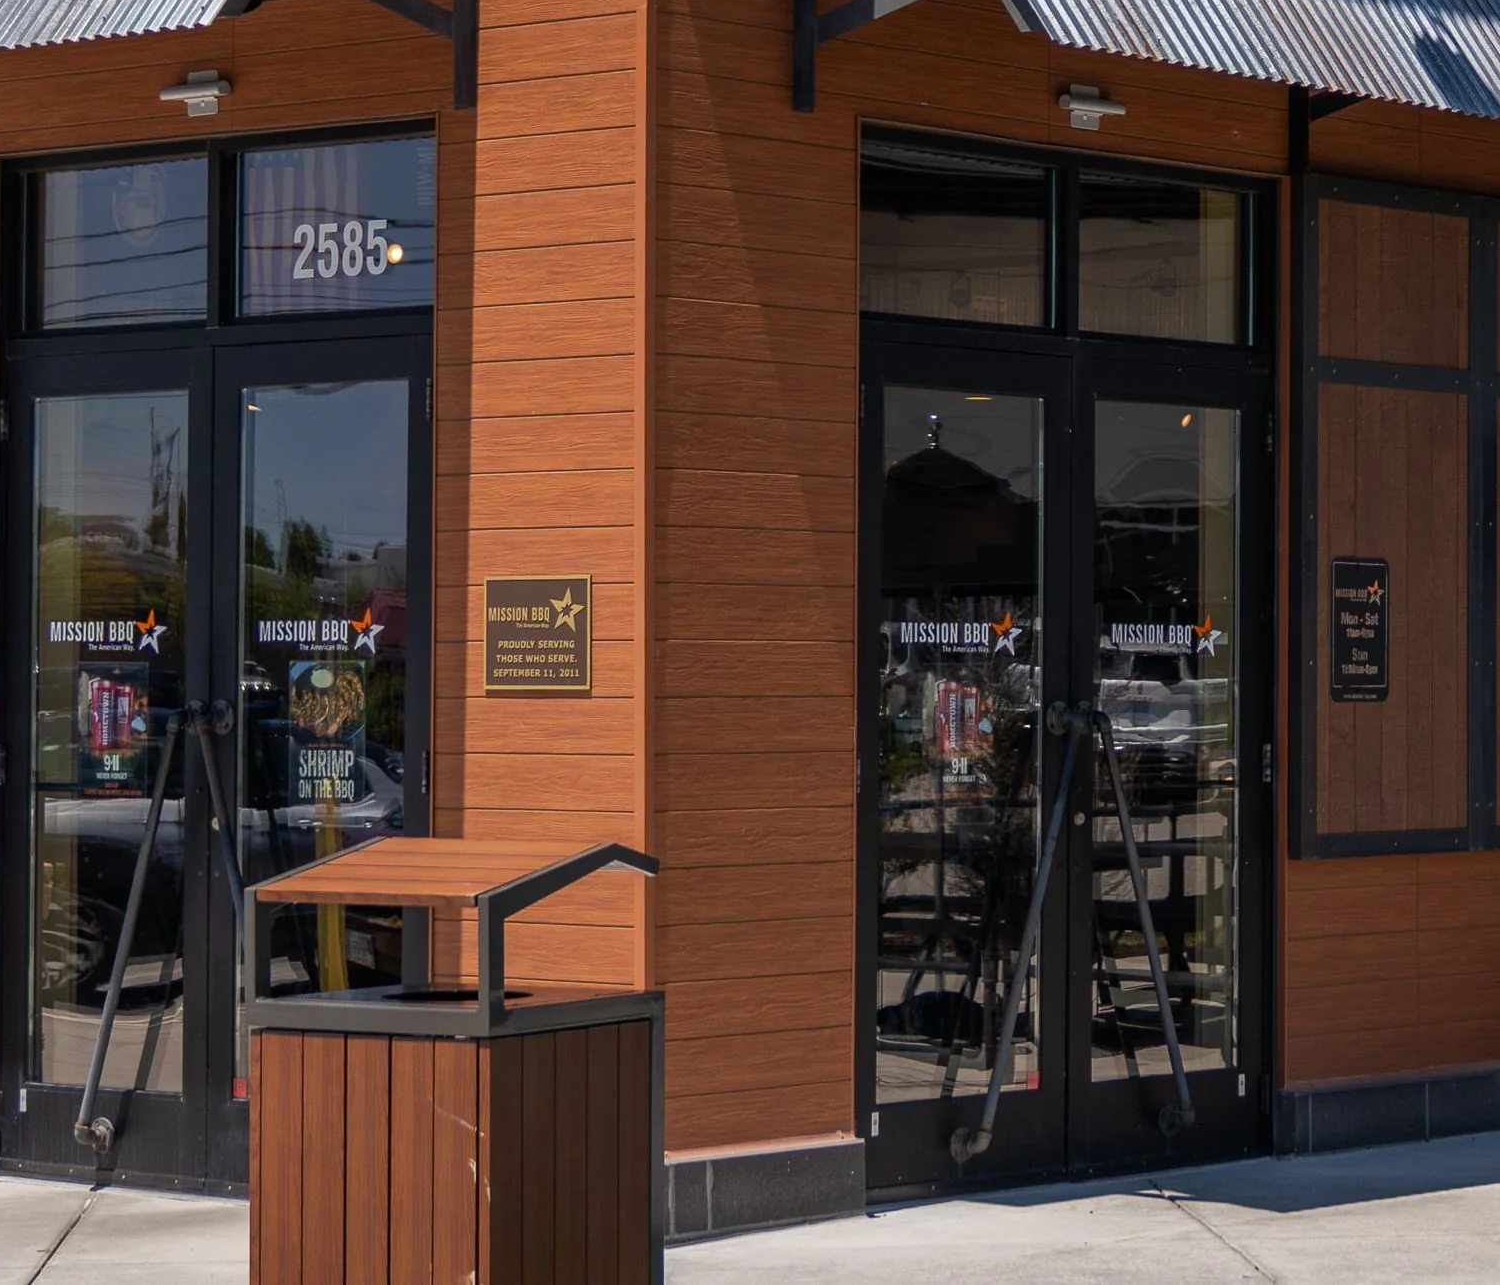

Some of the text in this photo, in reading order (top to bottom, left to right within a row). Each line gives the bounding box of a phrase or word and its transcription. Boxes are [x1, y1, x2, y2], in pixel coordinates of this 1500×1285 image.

[293, 219, 388, 279] 2585
[488, 607, 550, 622] MISSION BBQ
[1341, 612, 1358, 625] Mon
[1365, 612, 1379, 625] Sat
[50, 620, 135, 645] MISSION BBQ
[259, 620, 349, 645] MISSION BBQ
[901, 622, 990, 646] MISSION BBQ
[1112, 623, 1192, 647] MISSION BBQ
[88, 643, 97, 651] The
[98, 643, 122, 651] American
[299, 643, 309, 651] The
[310, 643, 335, 651] American
[498, 640, 575, 649] PROUDLY SERVING
[942, 645, 952, 653] The
[952, 645, 977, 653] American
[496, 654, 578, 663] THOSE WHO SERVE.
[1352, 647, 1368, 661] Sun
[493, 668, 580, 679] SEPTEMBER 11, 2011
[101, 691, 110, 746] HOMETOWN
[299, 749, 355, 778] SHRIMP
[298, 779, 355, 802] ON THE BBQ
